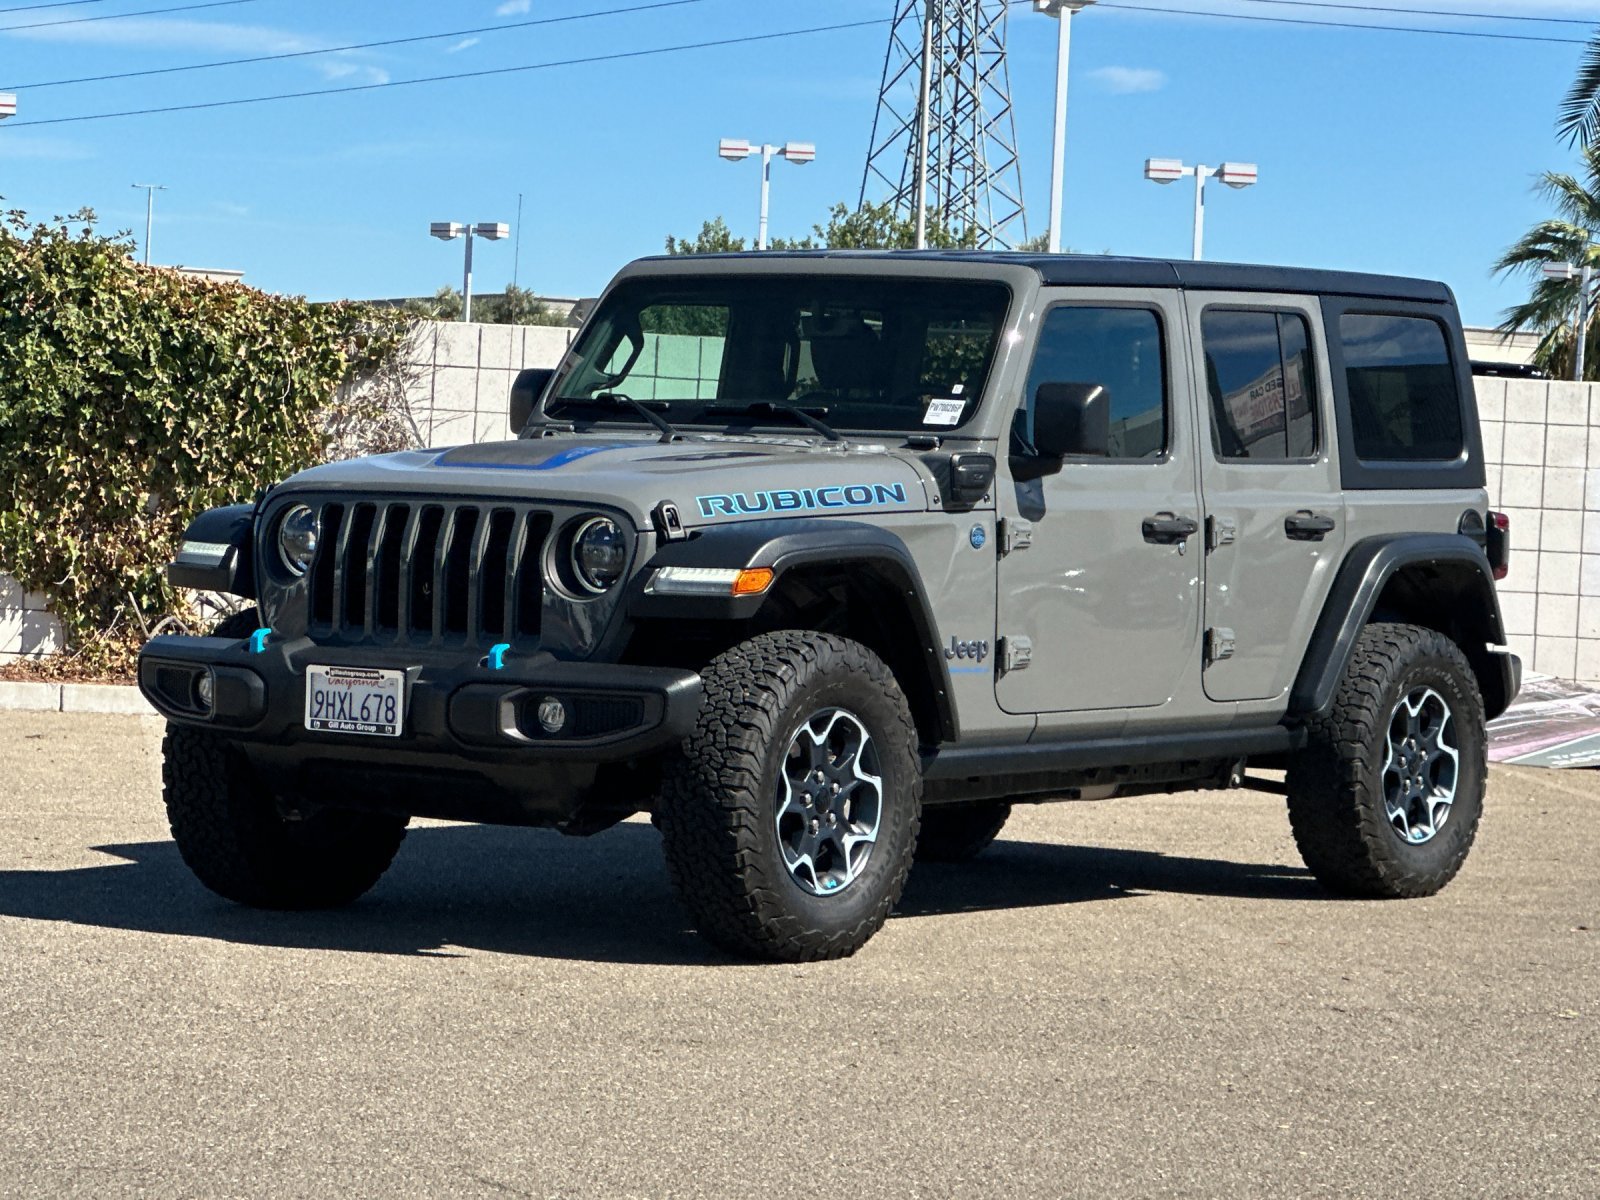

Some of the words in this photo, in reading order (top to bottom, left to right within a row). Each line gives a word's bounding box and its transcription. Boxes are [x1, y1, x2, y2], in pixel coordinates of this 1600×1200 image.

[697, 483, 907, 517] RUBICON
[944, 635, 989, 663] Jeep
[330, 669, 379, 678] gillautogroup.com
[314, 690, 395, 723] 9HXL678
[328, 721, 339, 729] Gill
[340, 722, 355, 730] Auto
[356, 723, 377, 733] Group
